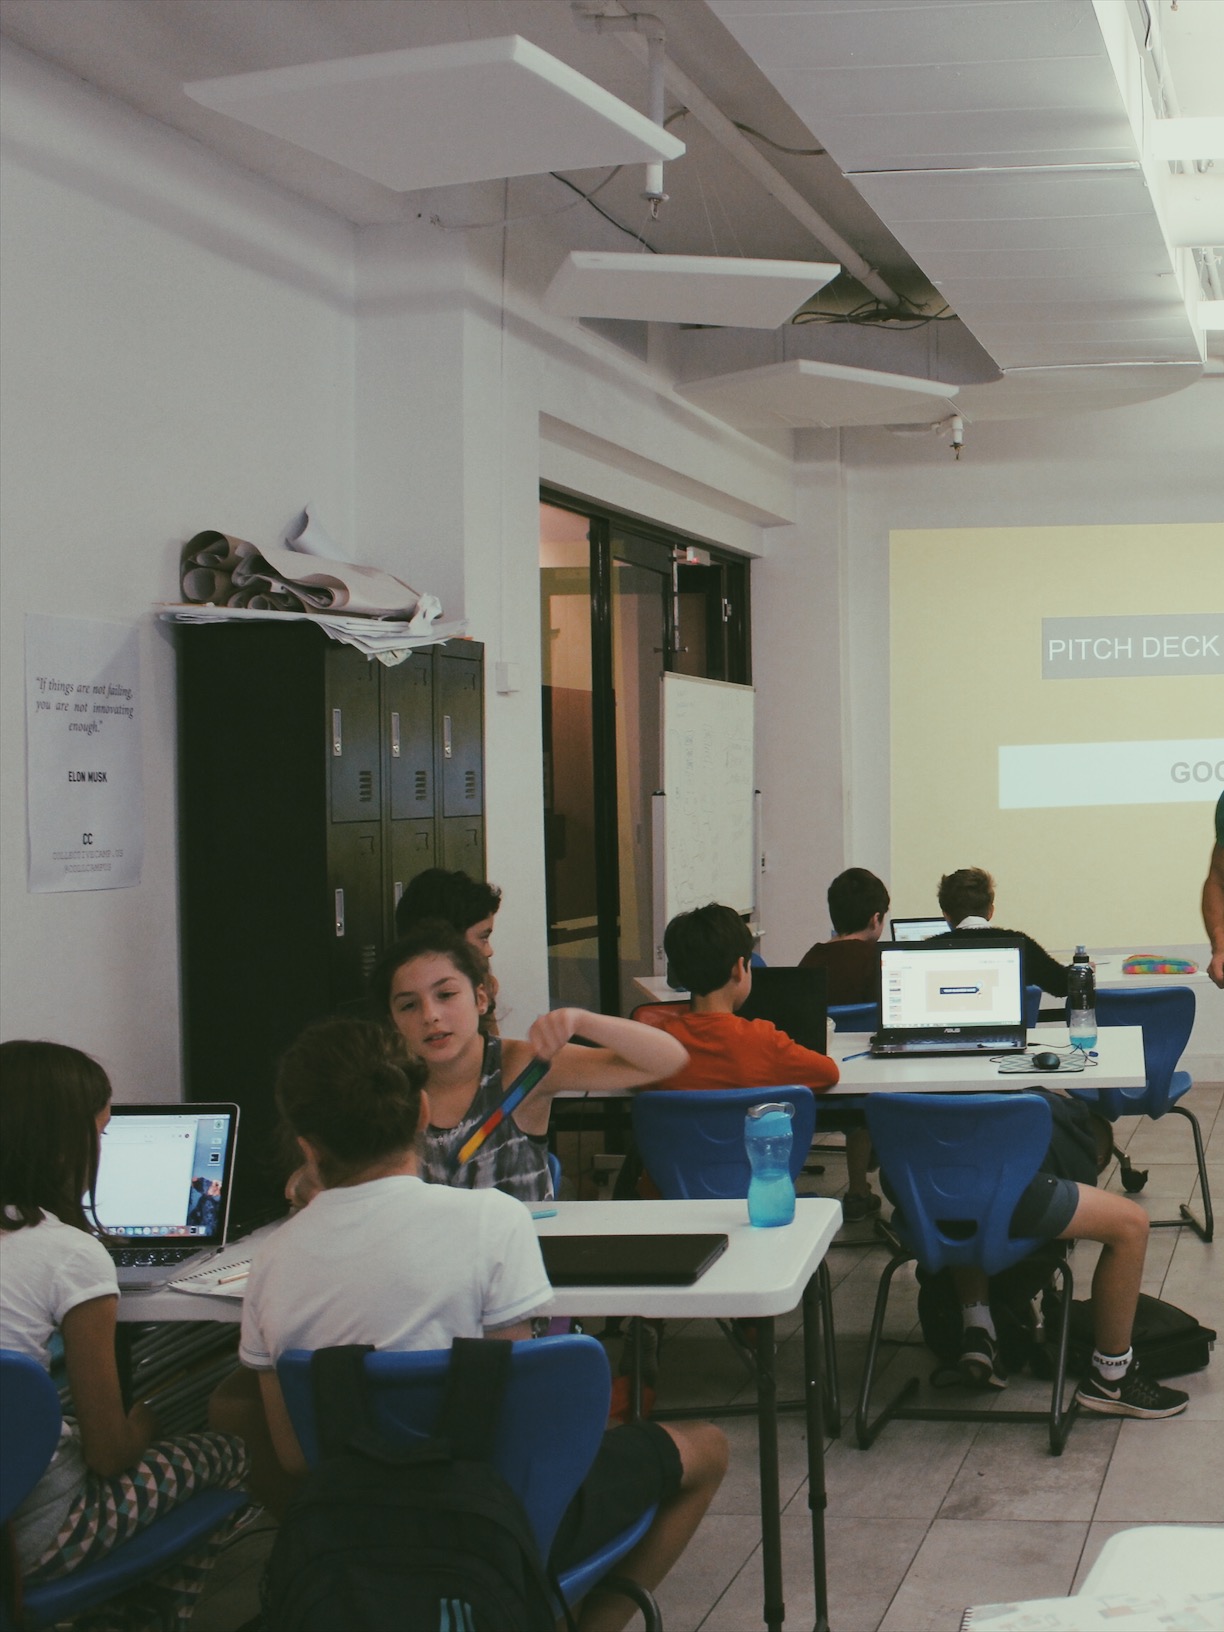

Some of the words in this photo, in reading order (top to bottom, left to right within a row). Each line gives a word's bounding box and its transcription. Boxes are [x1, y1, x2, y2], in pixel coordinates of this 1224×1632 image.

[1048, 637, 1132, 661] PITCH
[1142, 635, 1220, 659] DECK
[48, 679, 74, 696] things
[76, 684, 90, 694] are
[92, 685, 106, 695] not
[35, 700, 51, 713] you
[55, 702, 69, 711] are
[73, 703, 87, 713] not
[93, 703, 134, 719] innovating
[68, 770, 86, 782] ELON
[87, 771, 108, 783] MUSK
[82, 833, 93, 845] CC
